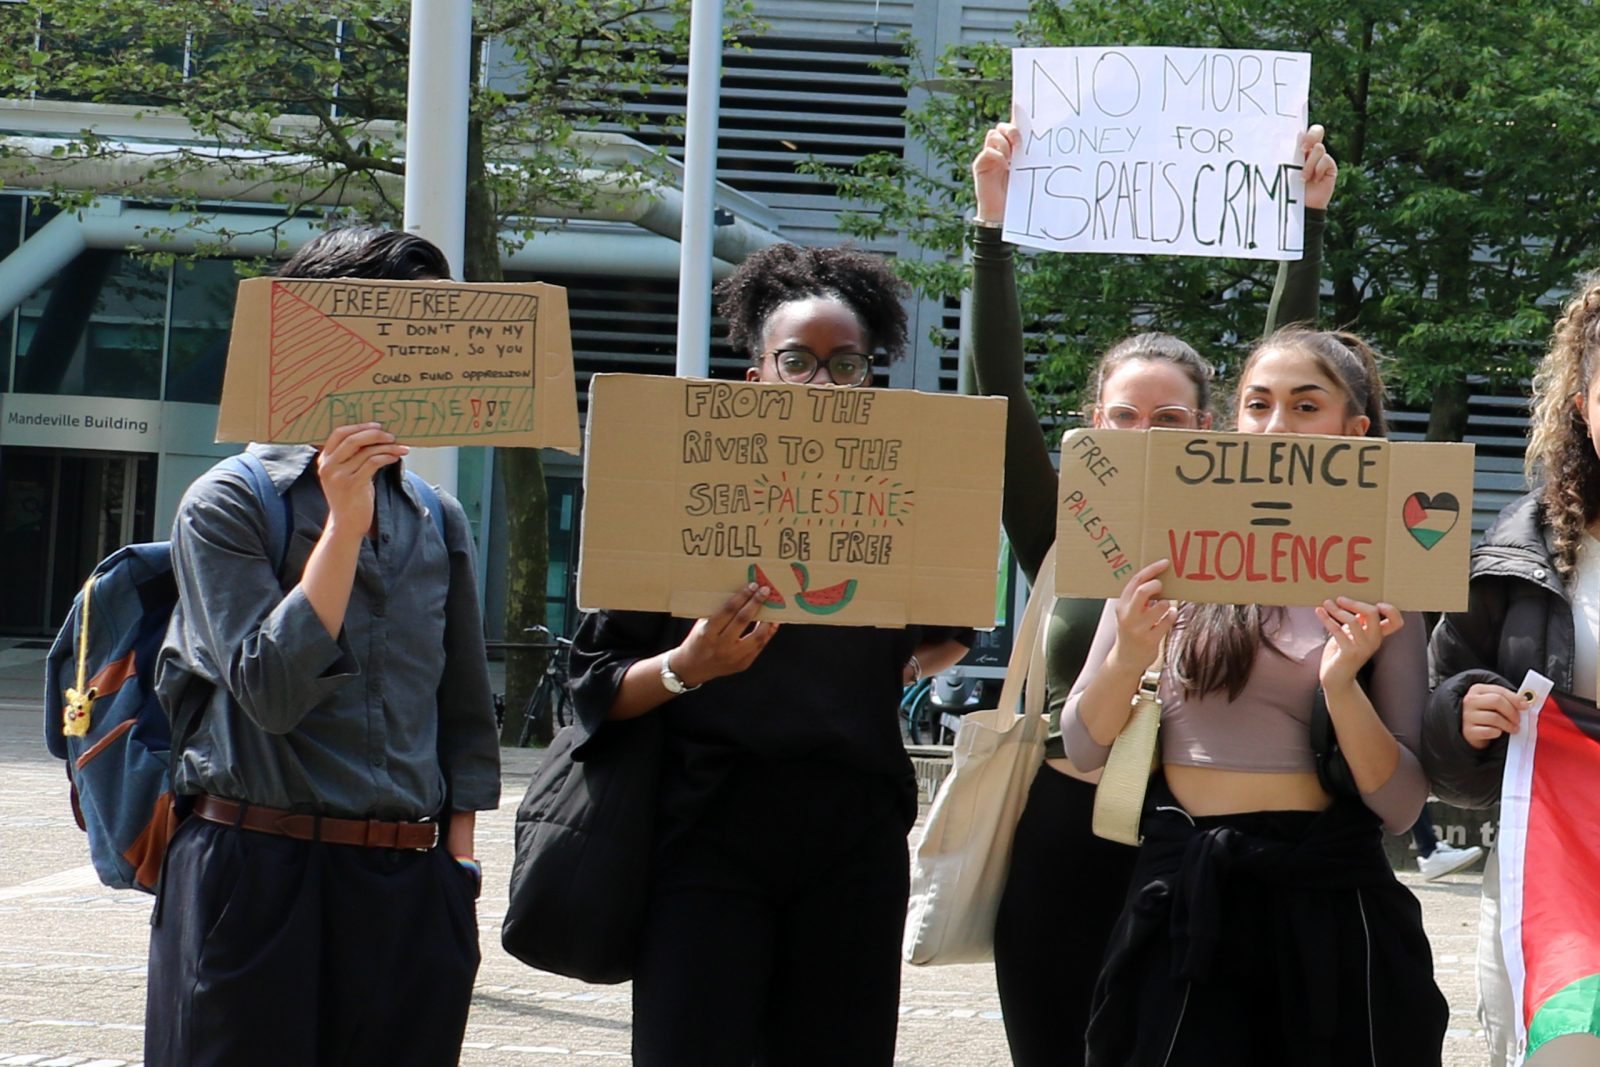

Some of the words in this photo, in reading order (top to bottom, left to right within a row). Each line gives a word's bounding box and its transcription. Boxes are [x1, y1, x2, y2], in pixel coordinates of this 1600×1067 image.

[1031, 51, 1141, 119] NO
[1161, 53, 1299, 118] MORE
[1025, 125, 1142, 157] MONEY
[1171, 126, 1235, 154] FOR
[1192, 160, 1304, 253] CRIME
[333, 288, 391, 314] FREE
[408, 289, 462, 316] FREE
[376, 323, 393, 336] I
[406, 323, 456, 336] DON'T
[468, 324, 493, 340] PAY
[501, 325, 524, 339] MY
[467, 343, 485, 356] SO
[496, 343, 523, 358] YOU
[372, 372, 412, 385] COULD
[419, 371, 454, 382] FUND
[461, 369, 531, 381] OPPRESSION
[8, 411, 80, 427] Mandeville
[83, 414, 148, 434] Building
[684, 383, 794, 420] FROM
[807, 387, 875, 425] THE
[778, 435, 824, 466] TO
[834, 436, 902, 471] THE
[1071, 435, 1119, 487] FREE
[1175, 439, 1383, 488] SILENCE
[684, 482, 751, 517] SEA
[767, 484, 901, 517] PALESTINE
[778, 527, 811, 562] BE
[828, 530, 893, 565] FREE
[1062, 490, 1133, 582] PALESTINE
[1167, 529, 1373, 583] VIOLENCE
